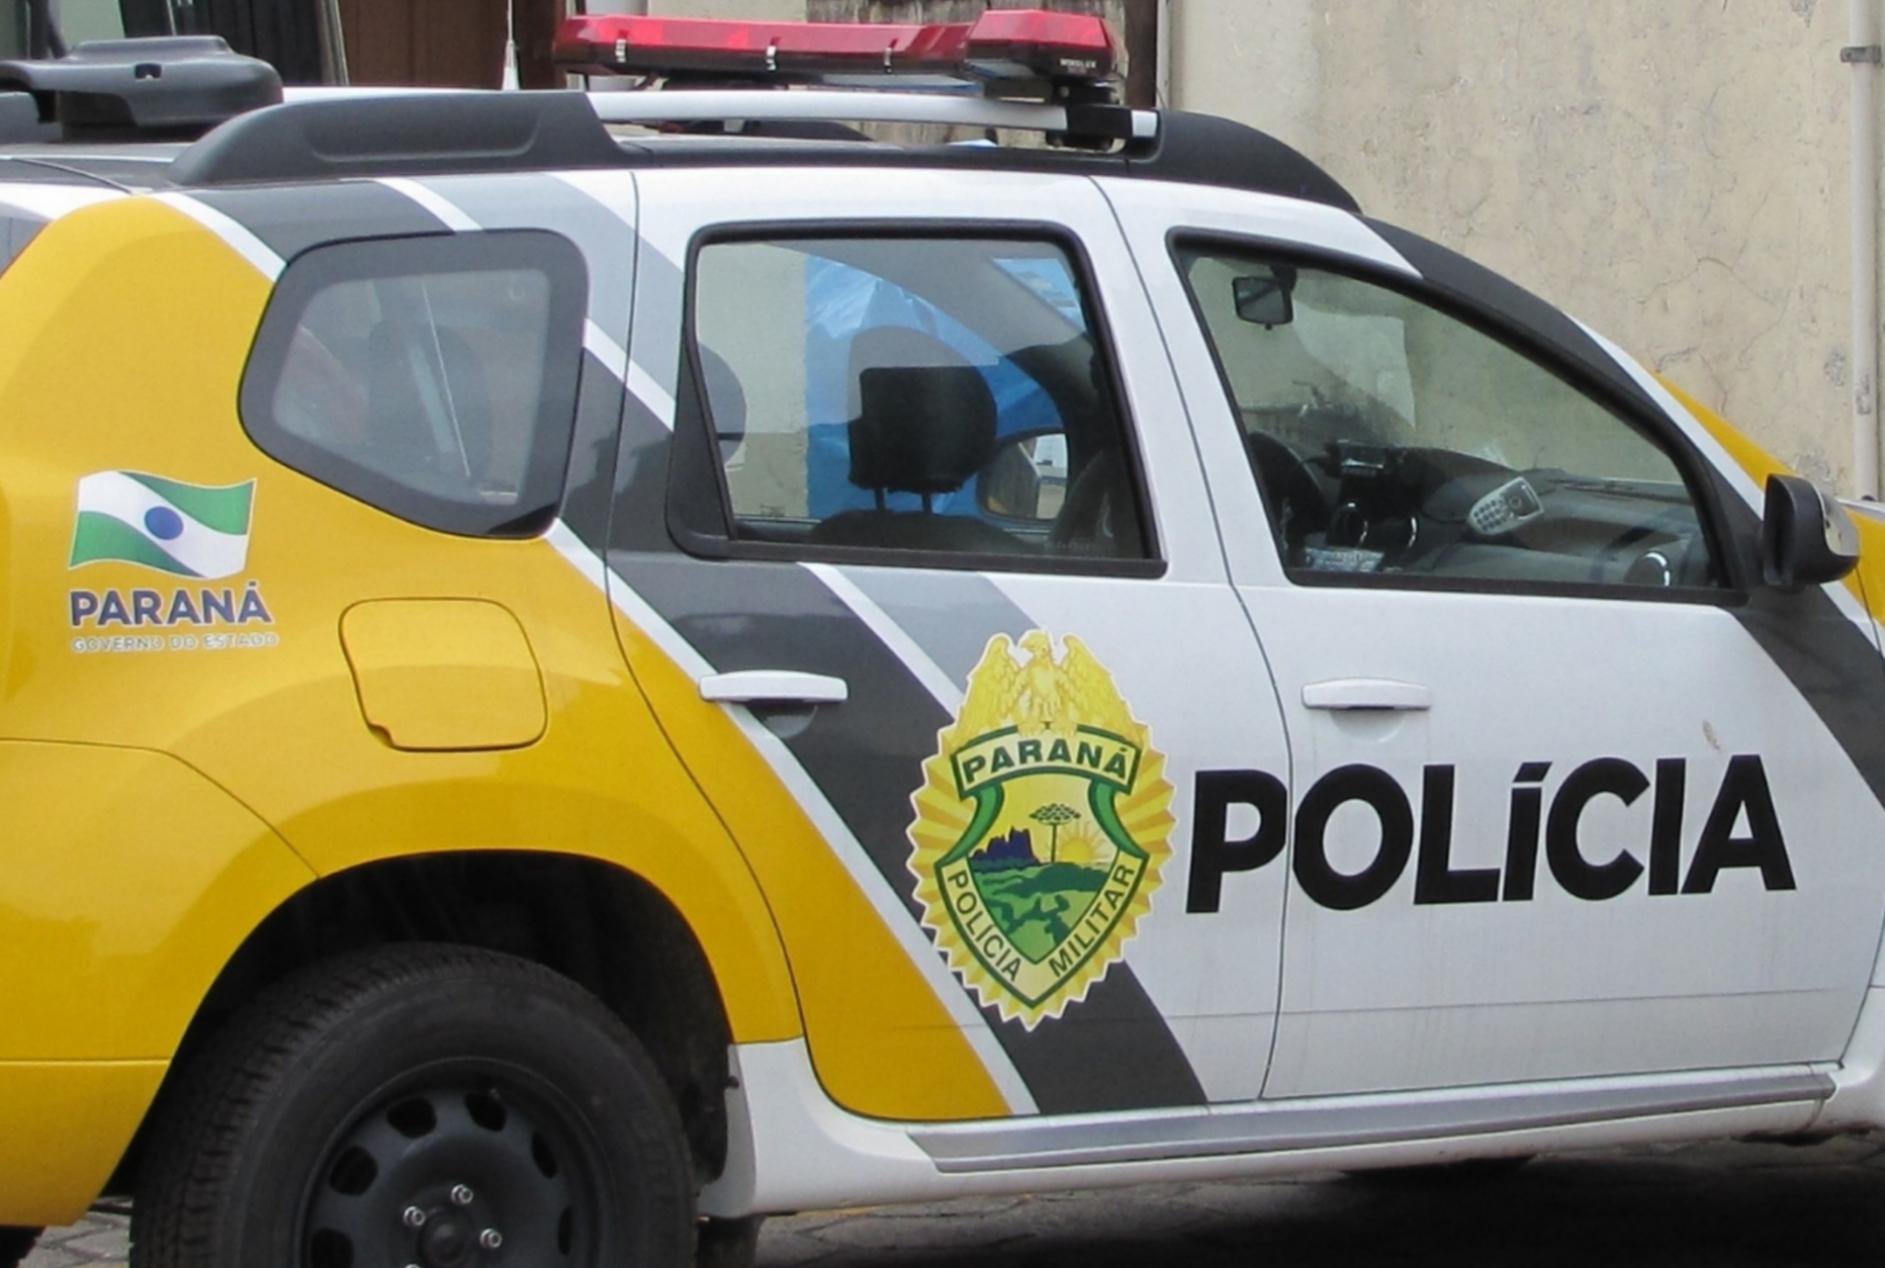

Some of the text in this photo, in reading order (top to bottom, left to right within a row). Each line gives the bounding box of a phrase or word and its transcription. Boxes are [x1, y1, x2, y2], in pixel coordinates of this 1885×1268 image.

[71, 582, 272, 626] PARANÁ
[74, 633, 278, 652] GOVERNO DO ESTADO
[961, 738, 1128, 783] PARANÁ
[1186, 755, 1796, 913] POLÍCIA
[1048, 864, 1135, 977] MILITAR
